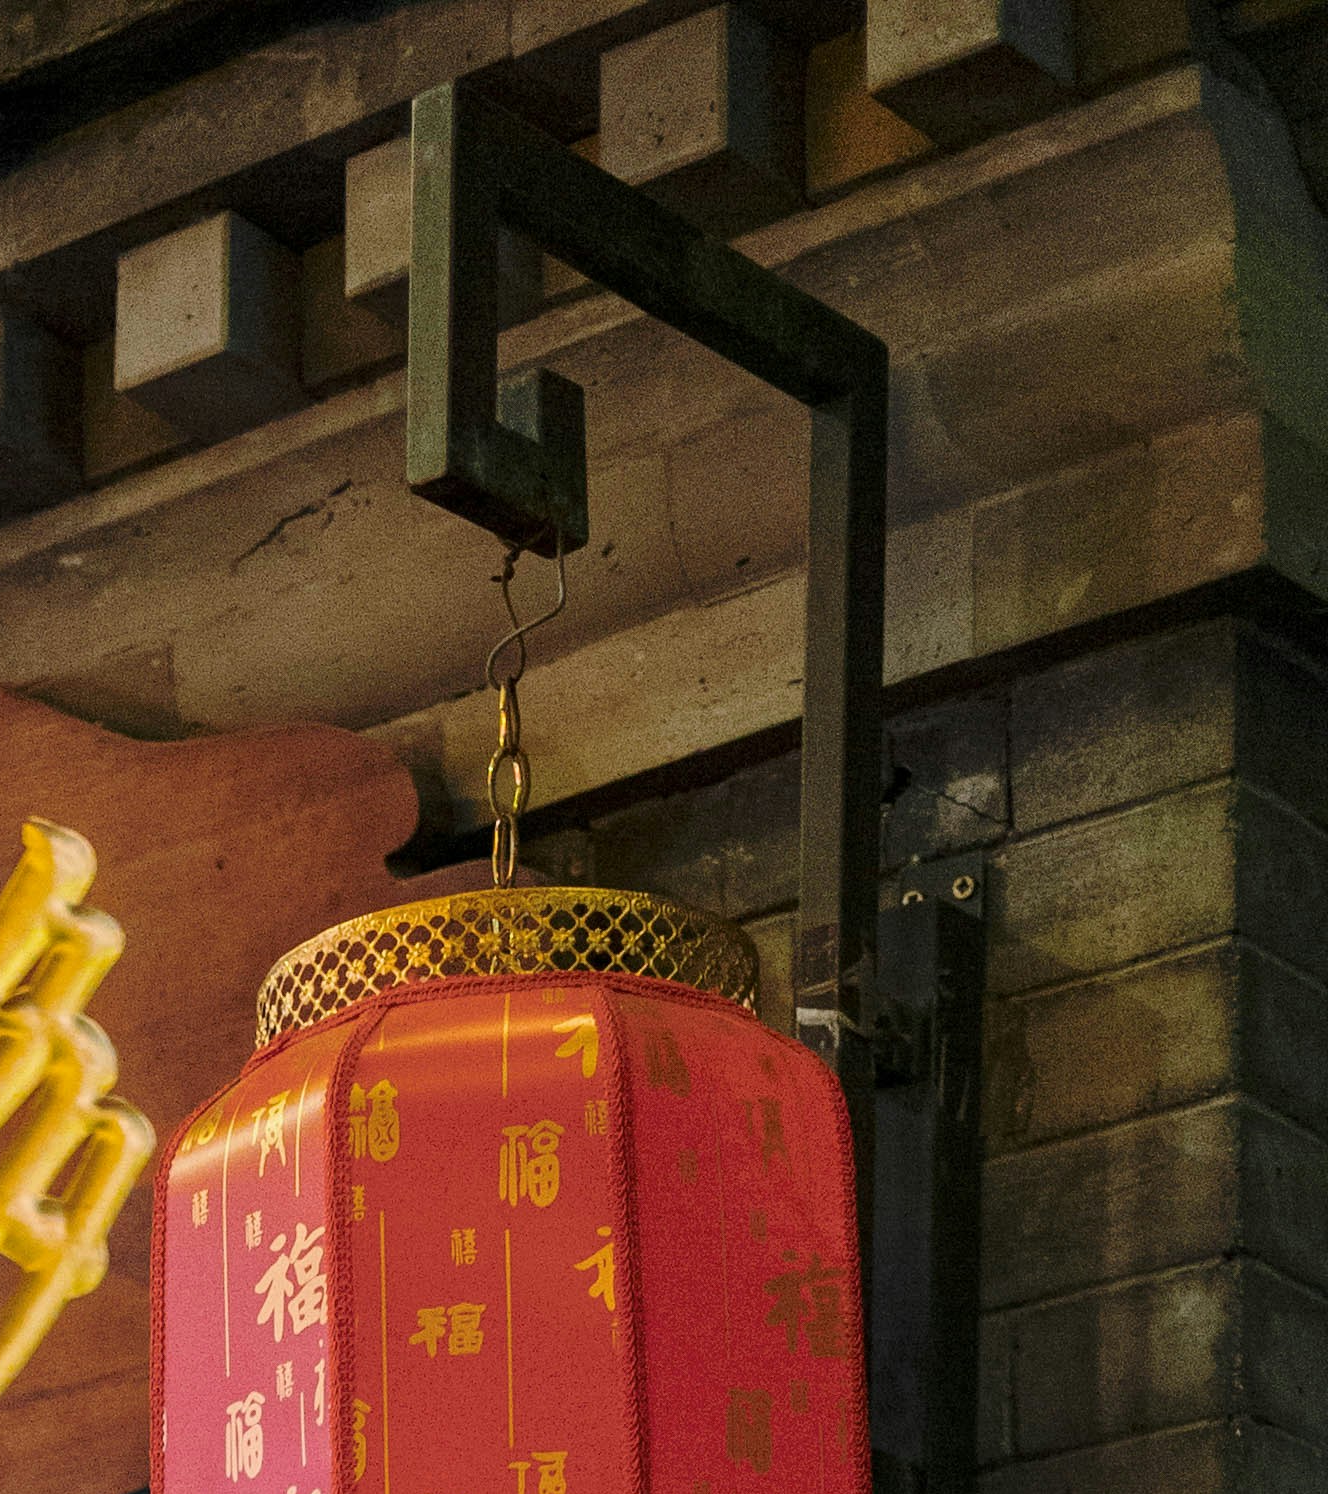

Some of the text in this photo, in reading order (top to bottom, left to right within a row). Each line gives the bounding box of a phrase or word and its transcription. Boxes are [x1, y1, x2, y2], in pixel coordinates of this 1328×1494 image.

[498, 1119, 566, 1208] 福
[254, 1222, 329, 1343] 福
[408, 1302, 487, 1359] 福
